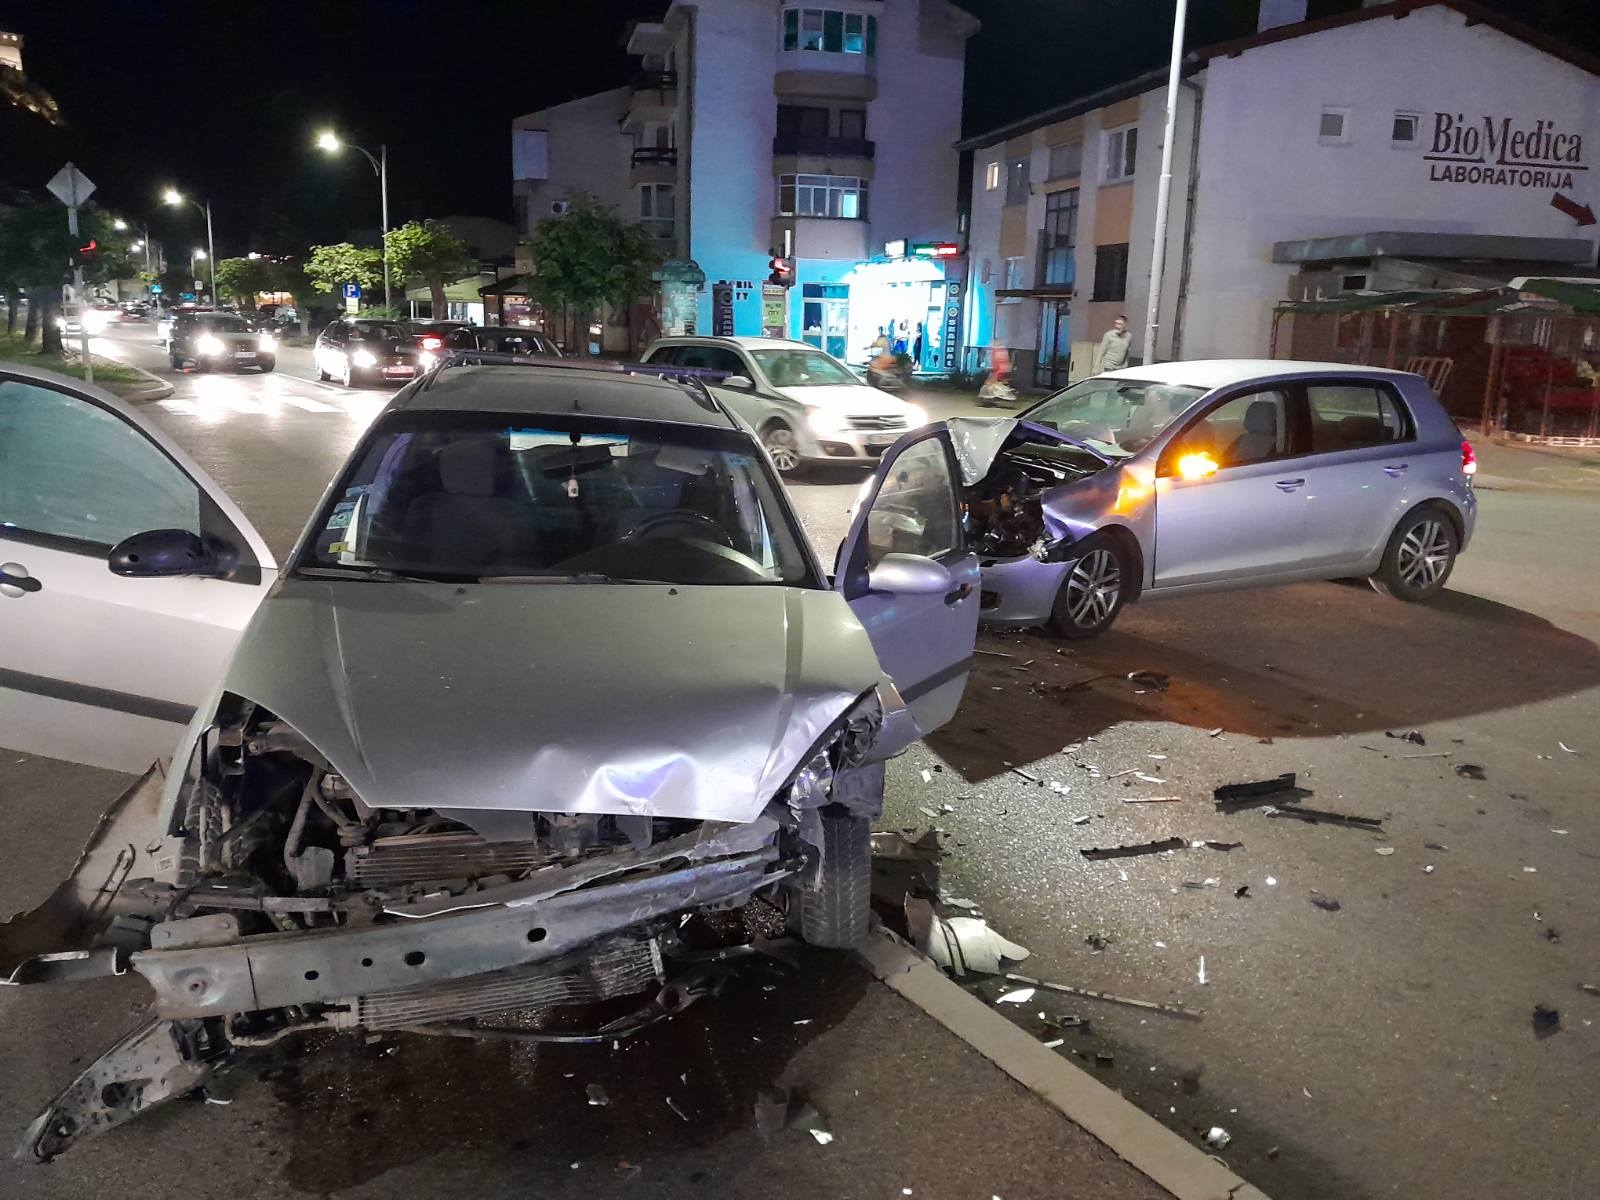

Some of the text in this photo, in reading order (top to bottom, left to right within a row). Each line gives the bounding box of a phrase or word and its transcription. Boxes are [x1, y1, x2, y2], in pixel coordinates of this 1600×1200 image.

[1430, 112, 1582, 163] BioMedica
[1429, 165, 1574, 189] LABORATORIJA
[347, 284, 357, 297] P
